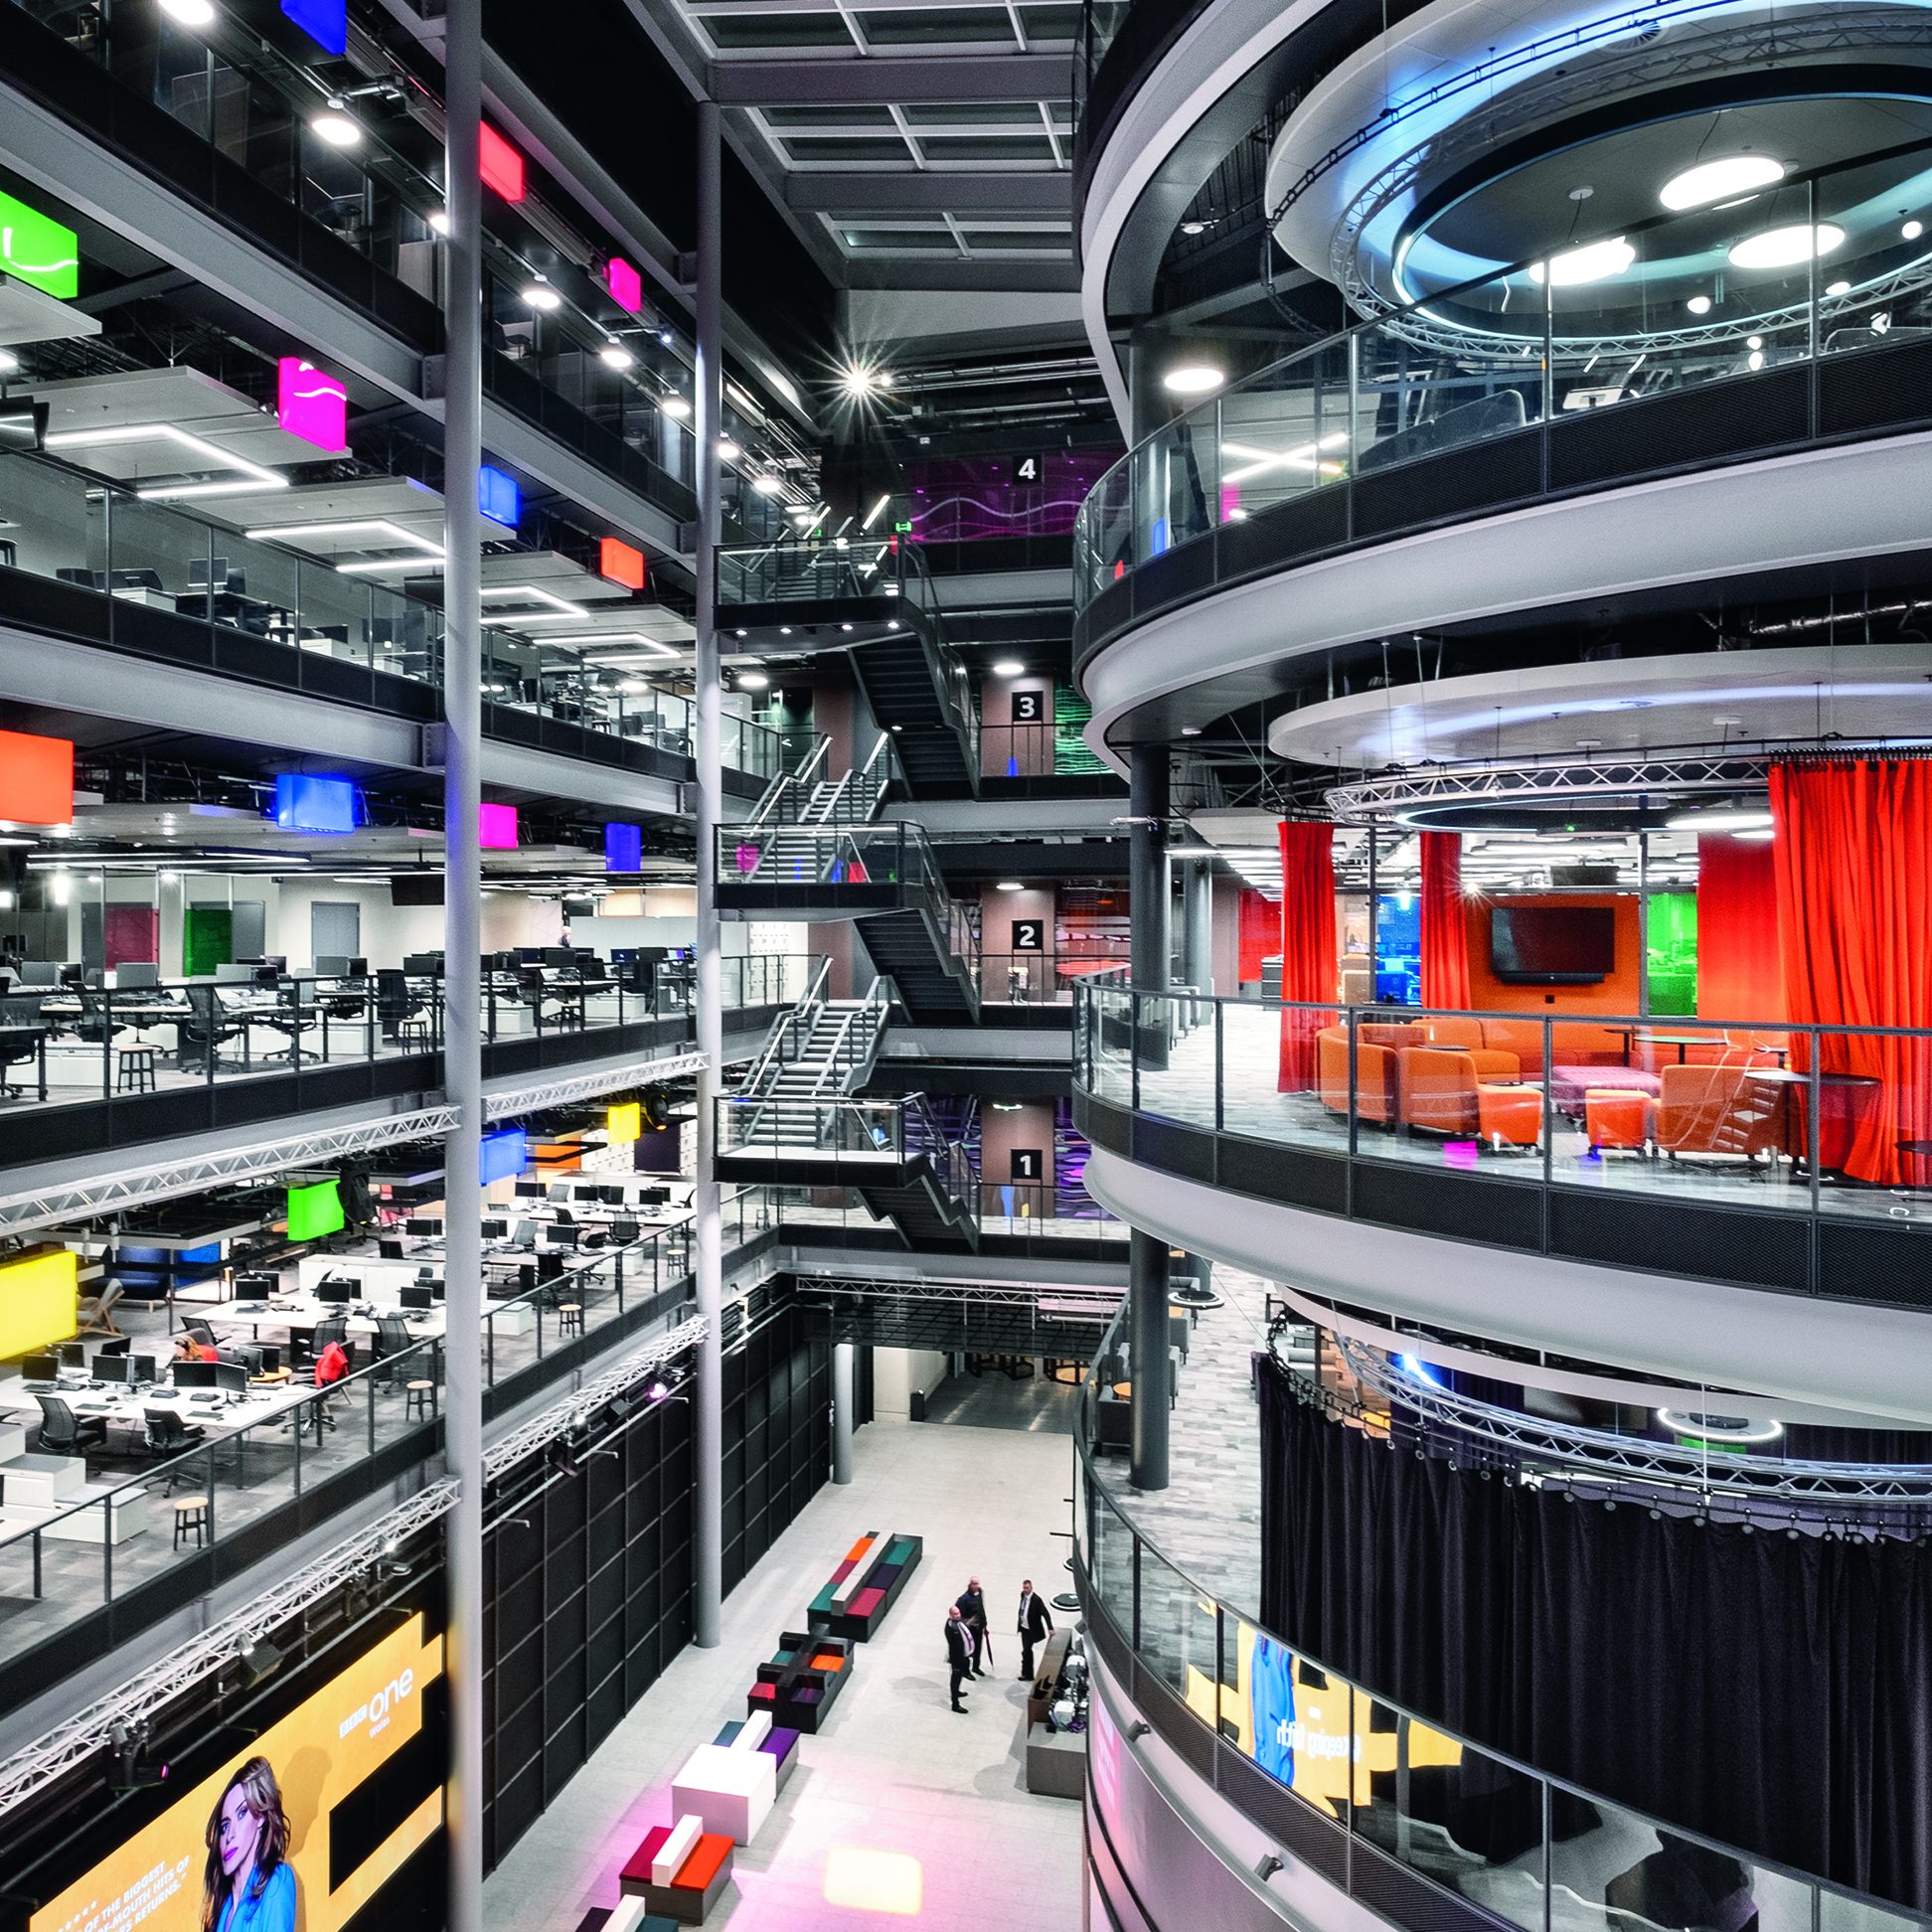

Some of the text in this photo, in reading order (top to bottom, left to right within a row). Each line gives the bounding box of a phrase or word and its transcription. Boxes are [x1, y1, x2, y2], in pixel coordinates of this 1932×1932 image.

[1018, 458, 1037, 479] 4
[1019, 696, 1035, 718] 3
[1019, 924, 1036, 946] 2
[1020, 1155, 1032, 1176] 1
[339, 1669, 413, 1739] BBC one
[369, 1716, 391, 1738] Wales
[153, 1868, 175, 1893] HITS
[176, 1854, 191, 1873] OF
[102, 1897, 121, 1921] THE
[123, 1860, 166, 1903] BIGGEST
